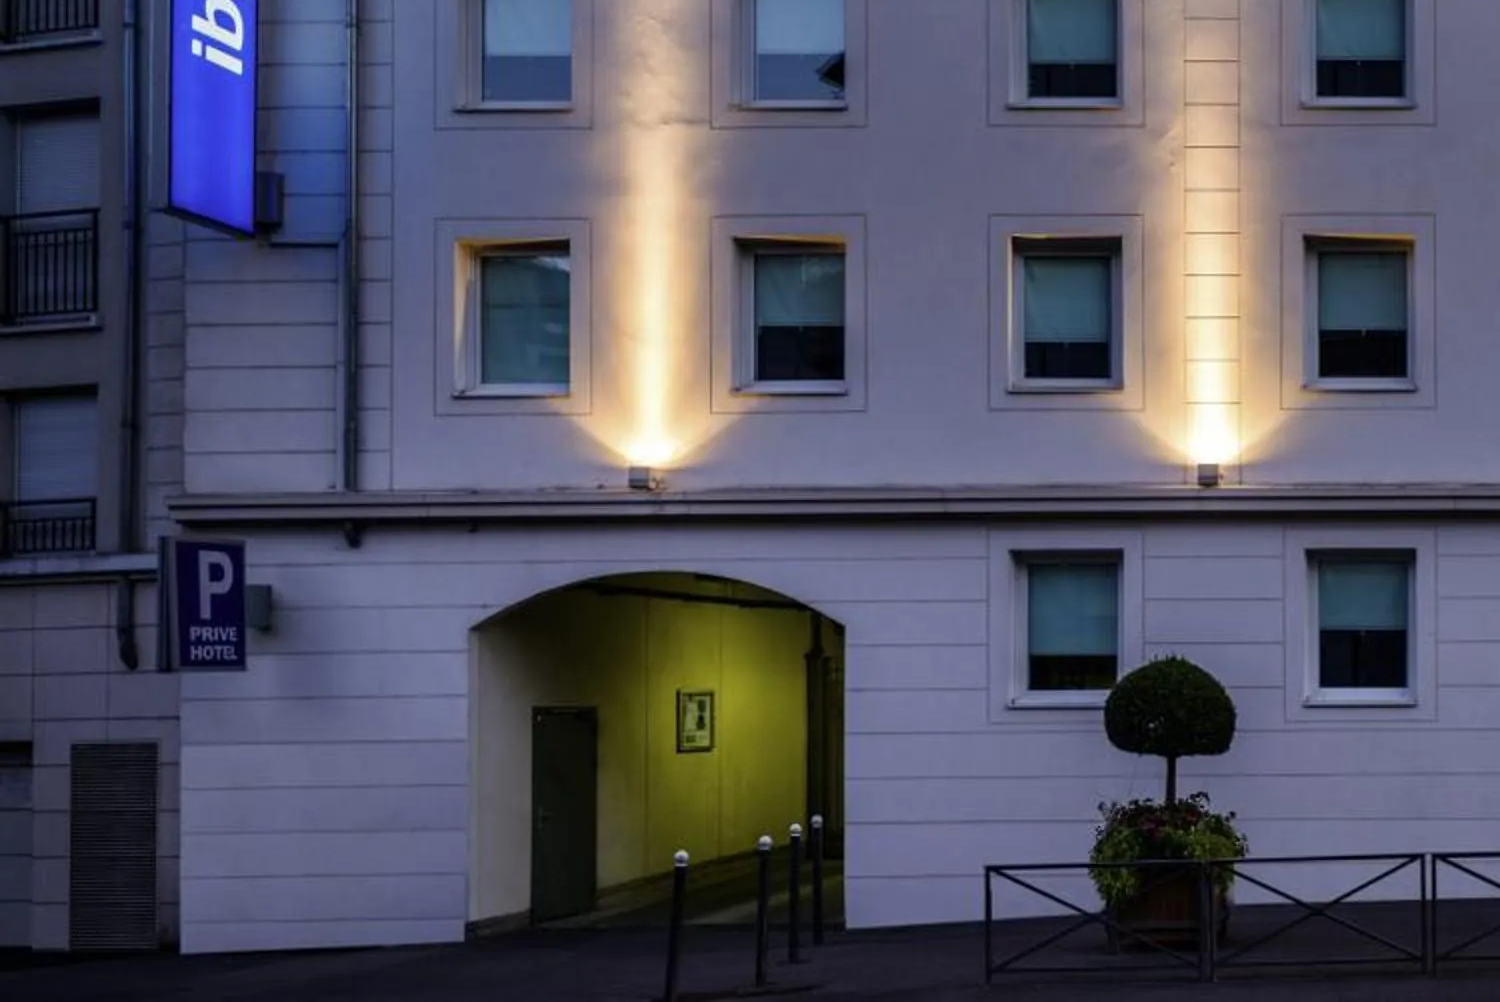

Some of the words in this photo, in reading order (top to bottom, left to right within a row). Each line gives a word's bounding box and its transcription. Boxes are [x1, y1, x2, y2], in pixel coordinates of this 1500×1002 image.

[198, 549, 234, 620] P
[189, 626, 239, 642] PRIVE
[190, 645, 239, 661] HOTEL
